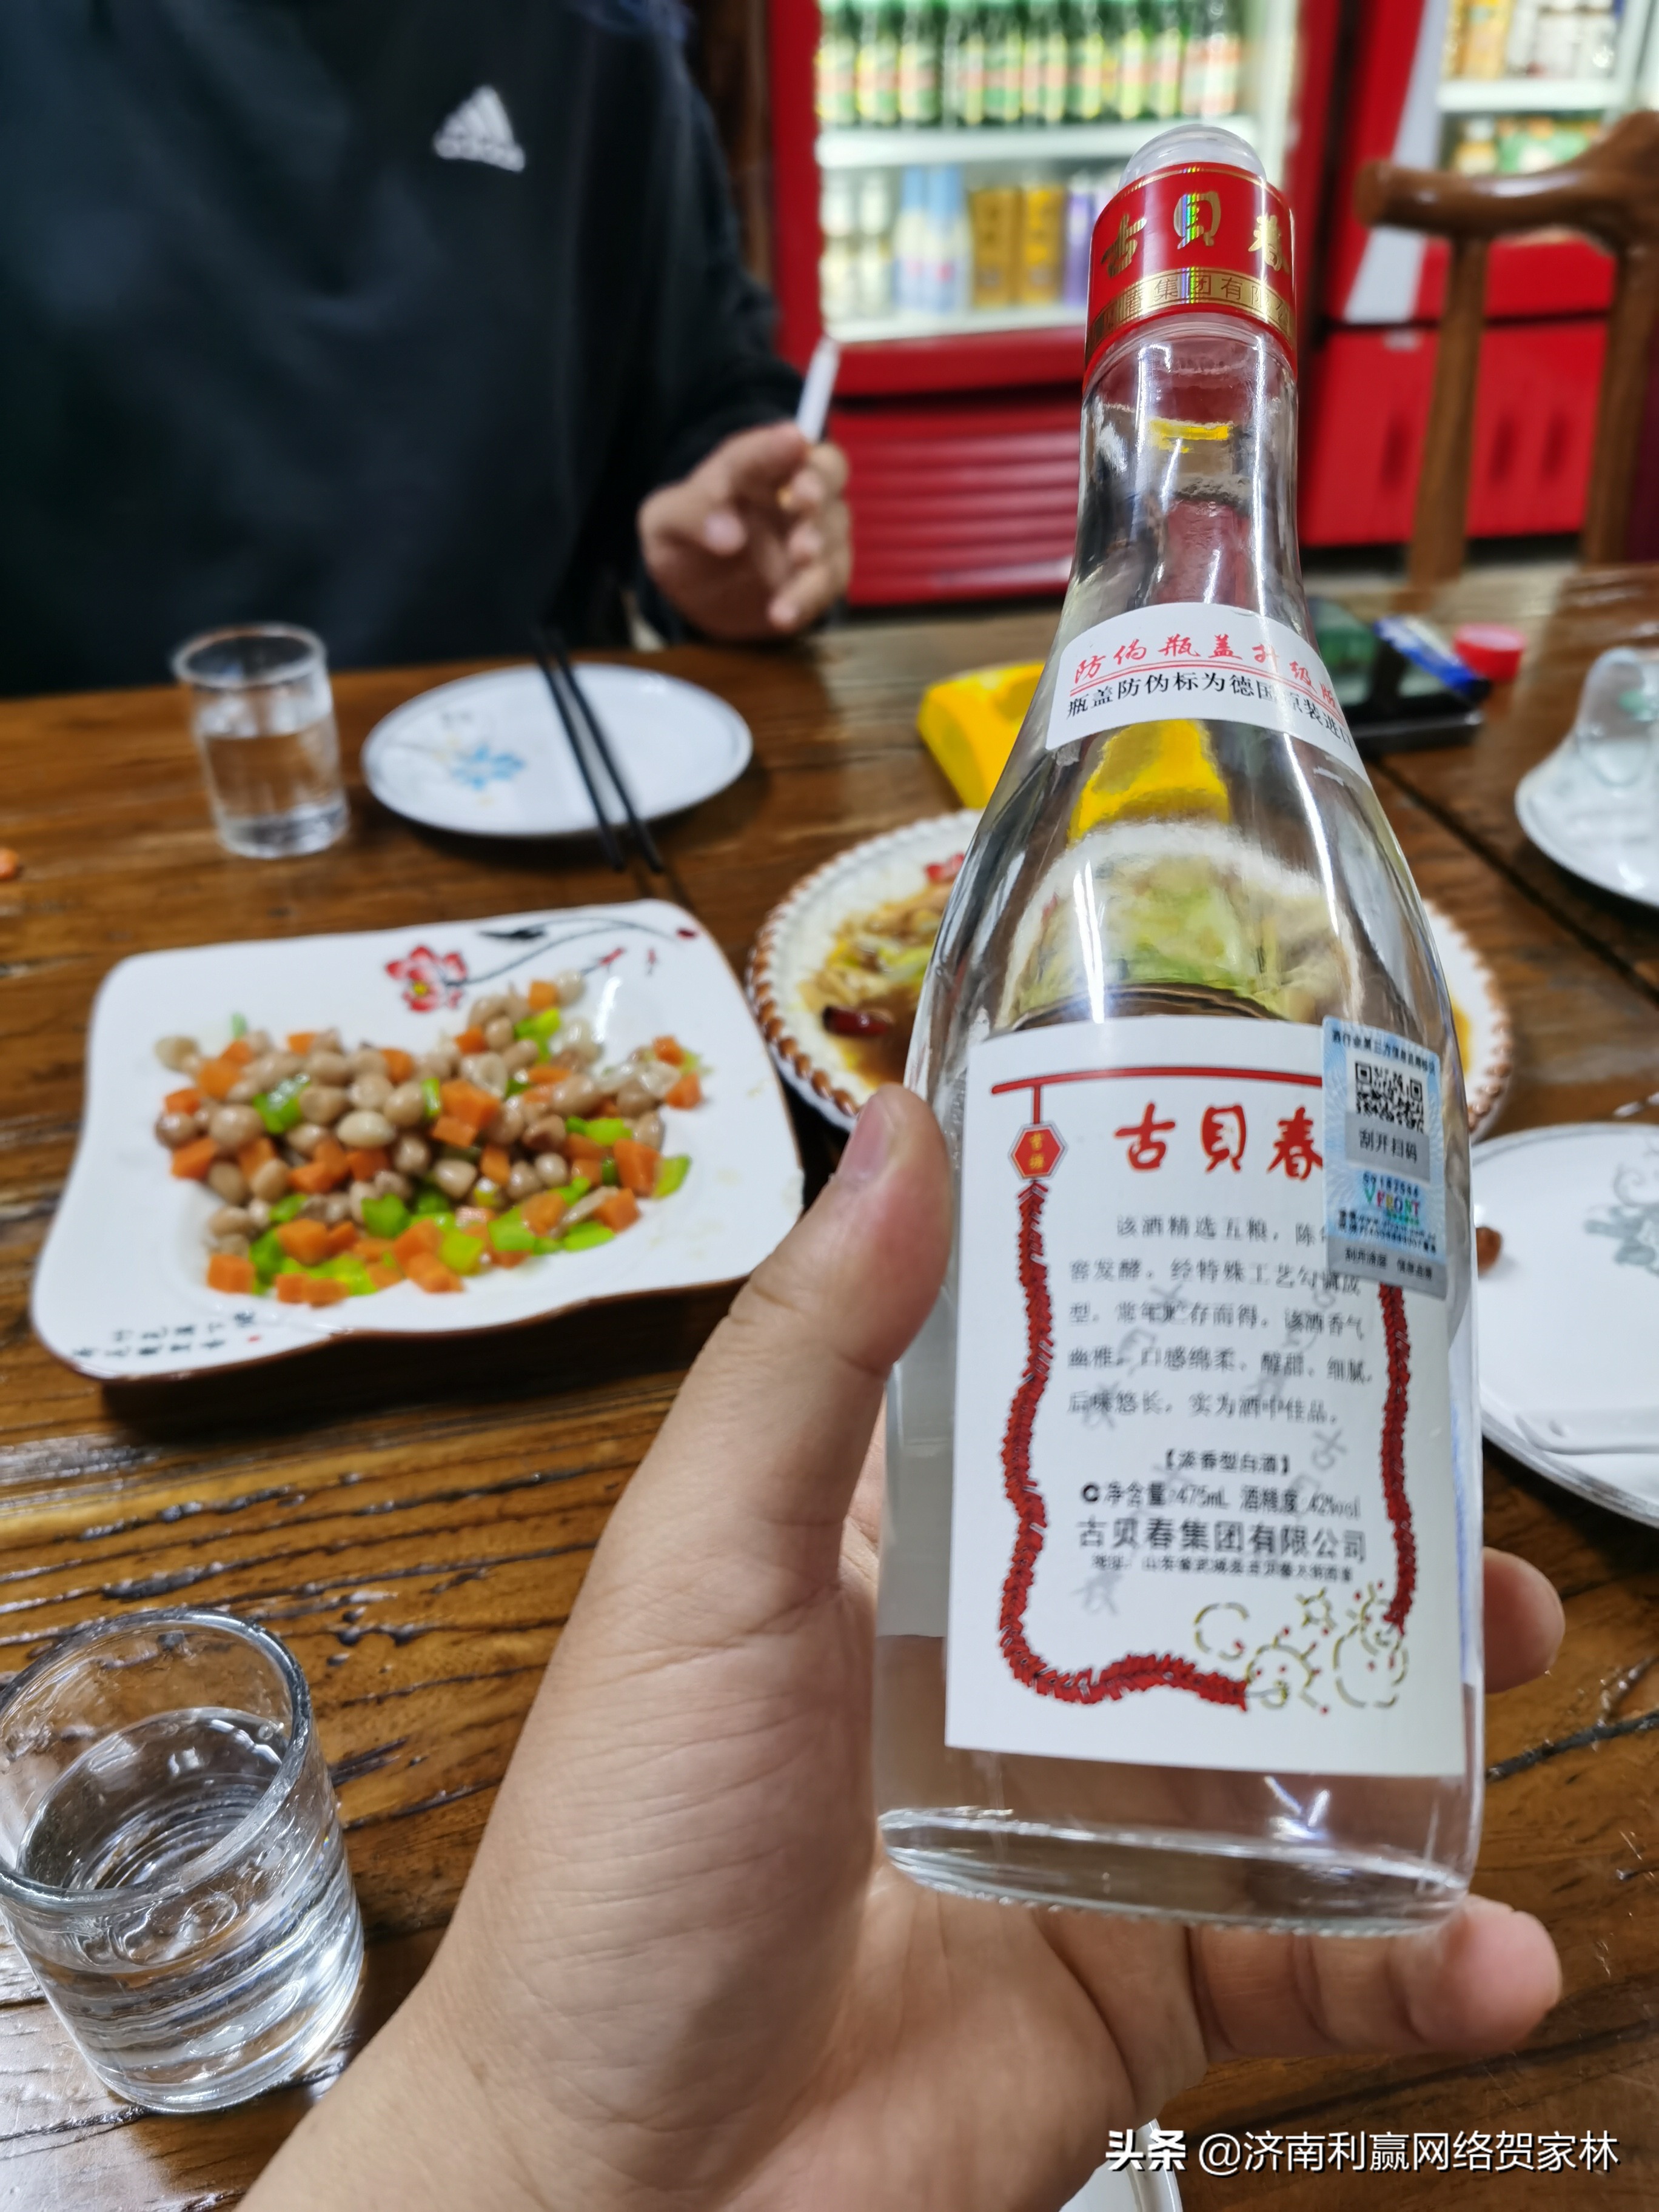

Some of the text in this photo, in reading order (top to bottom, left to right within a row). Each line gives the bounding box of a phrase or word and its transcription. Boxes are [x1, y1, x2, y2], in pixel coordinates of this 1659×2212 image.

[1101, 191, 1290, 278] 古贝春
[1113, 1102, 1323, 1181] 古贝春
[1359, 1128, 1418, 1162] 刮开扫码
[1117, 1215, 1325, 1247] 该酒精选五粮，陈
[1077, 1517, 1366, 1562] 古贝春集团有限公司
